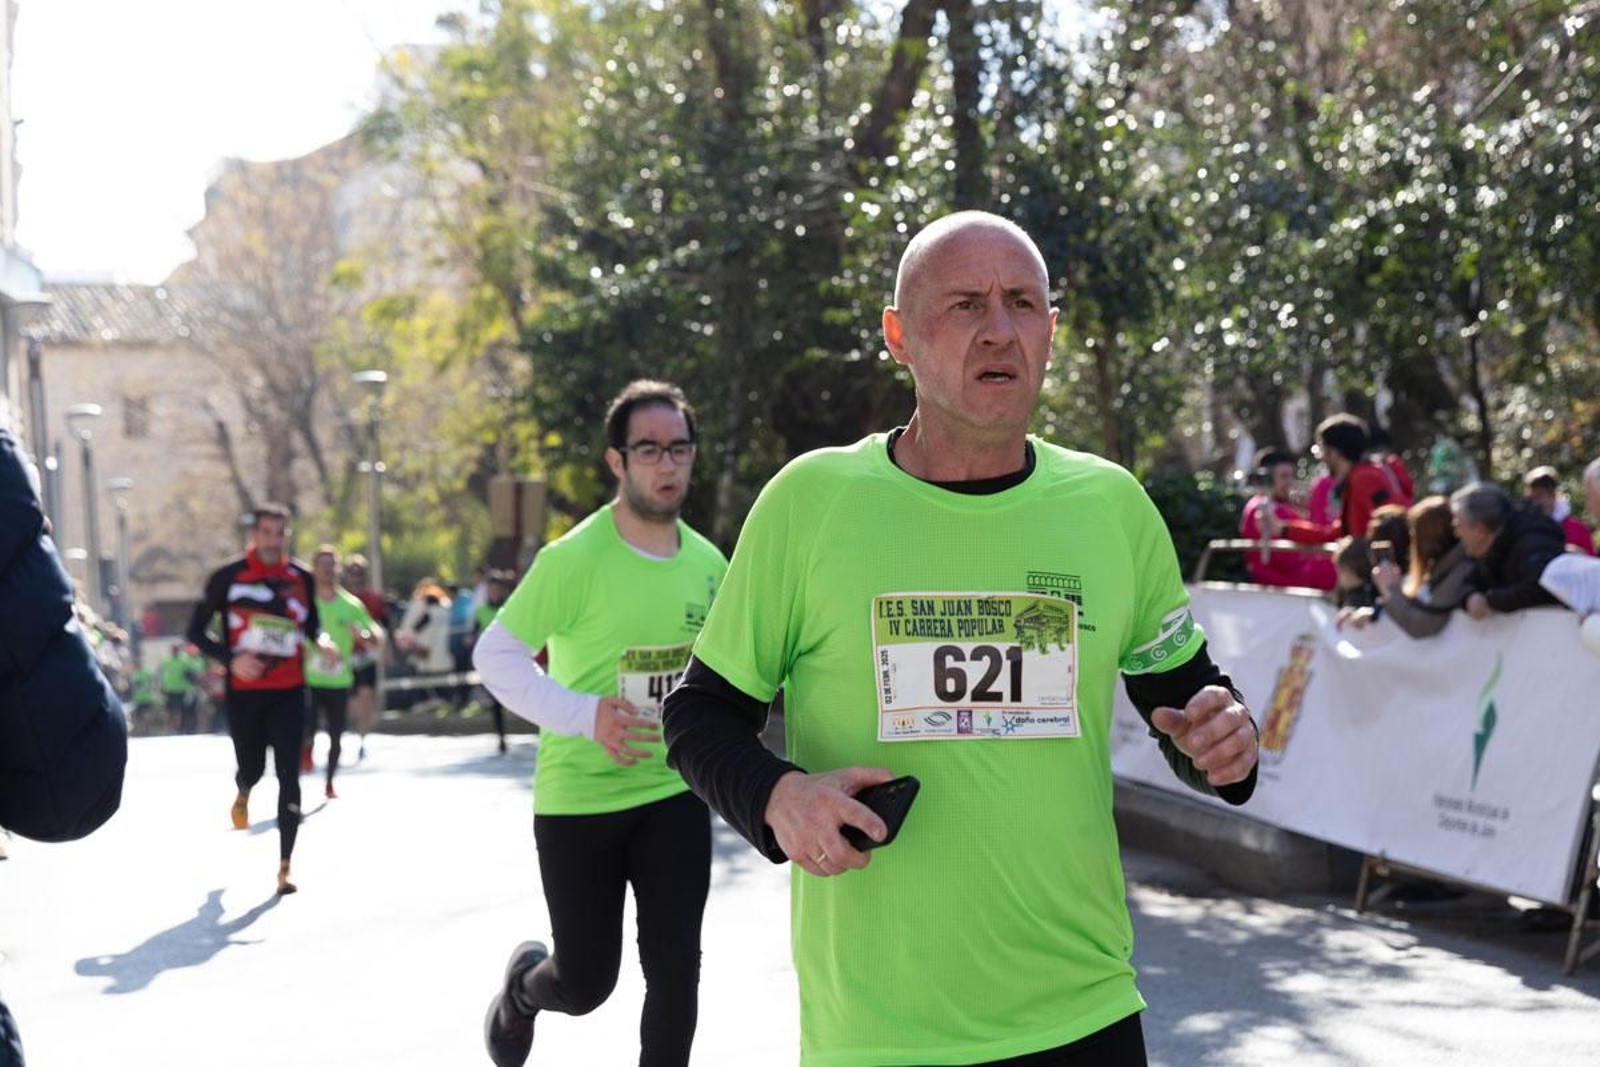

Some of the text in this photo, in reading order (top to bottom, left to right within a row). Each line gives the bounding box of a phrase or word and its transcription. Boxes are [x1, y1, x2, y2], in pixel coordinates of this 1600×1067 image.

[879, 600, 907, 618] I.E.S.
[911, 600, 935, 616] SAN
[940, 600, 972, 616] JUAN
[977, 599, 1011, 617] BOSCO
[889, 619, 1005, 638] IV CARRERA POPULAR
[933, 645, 1023, 703] 621
[1037, 714, 1070, 723] cerebral
